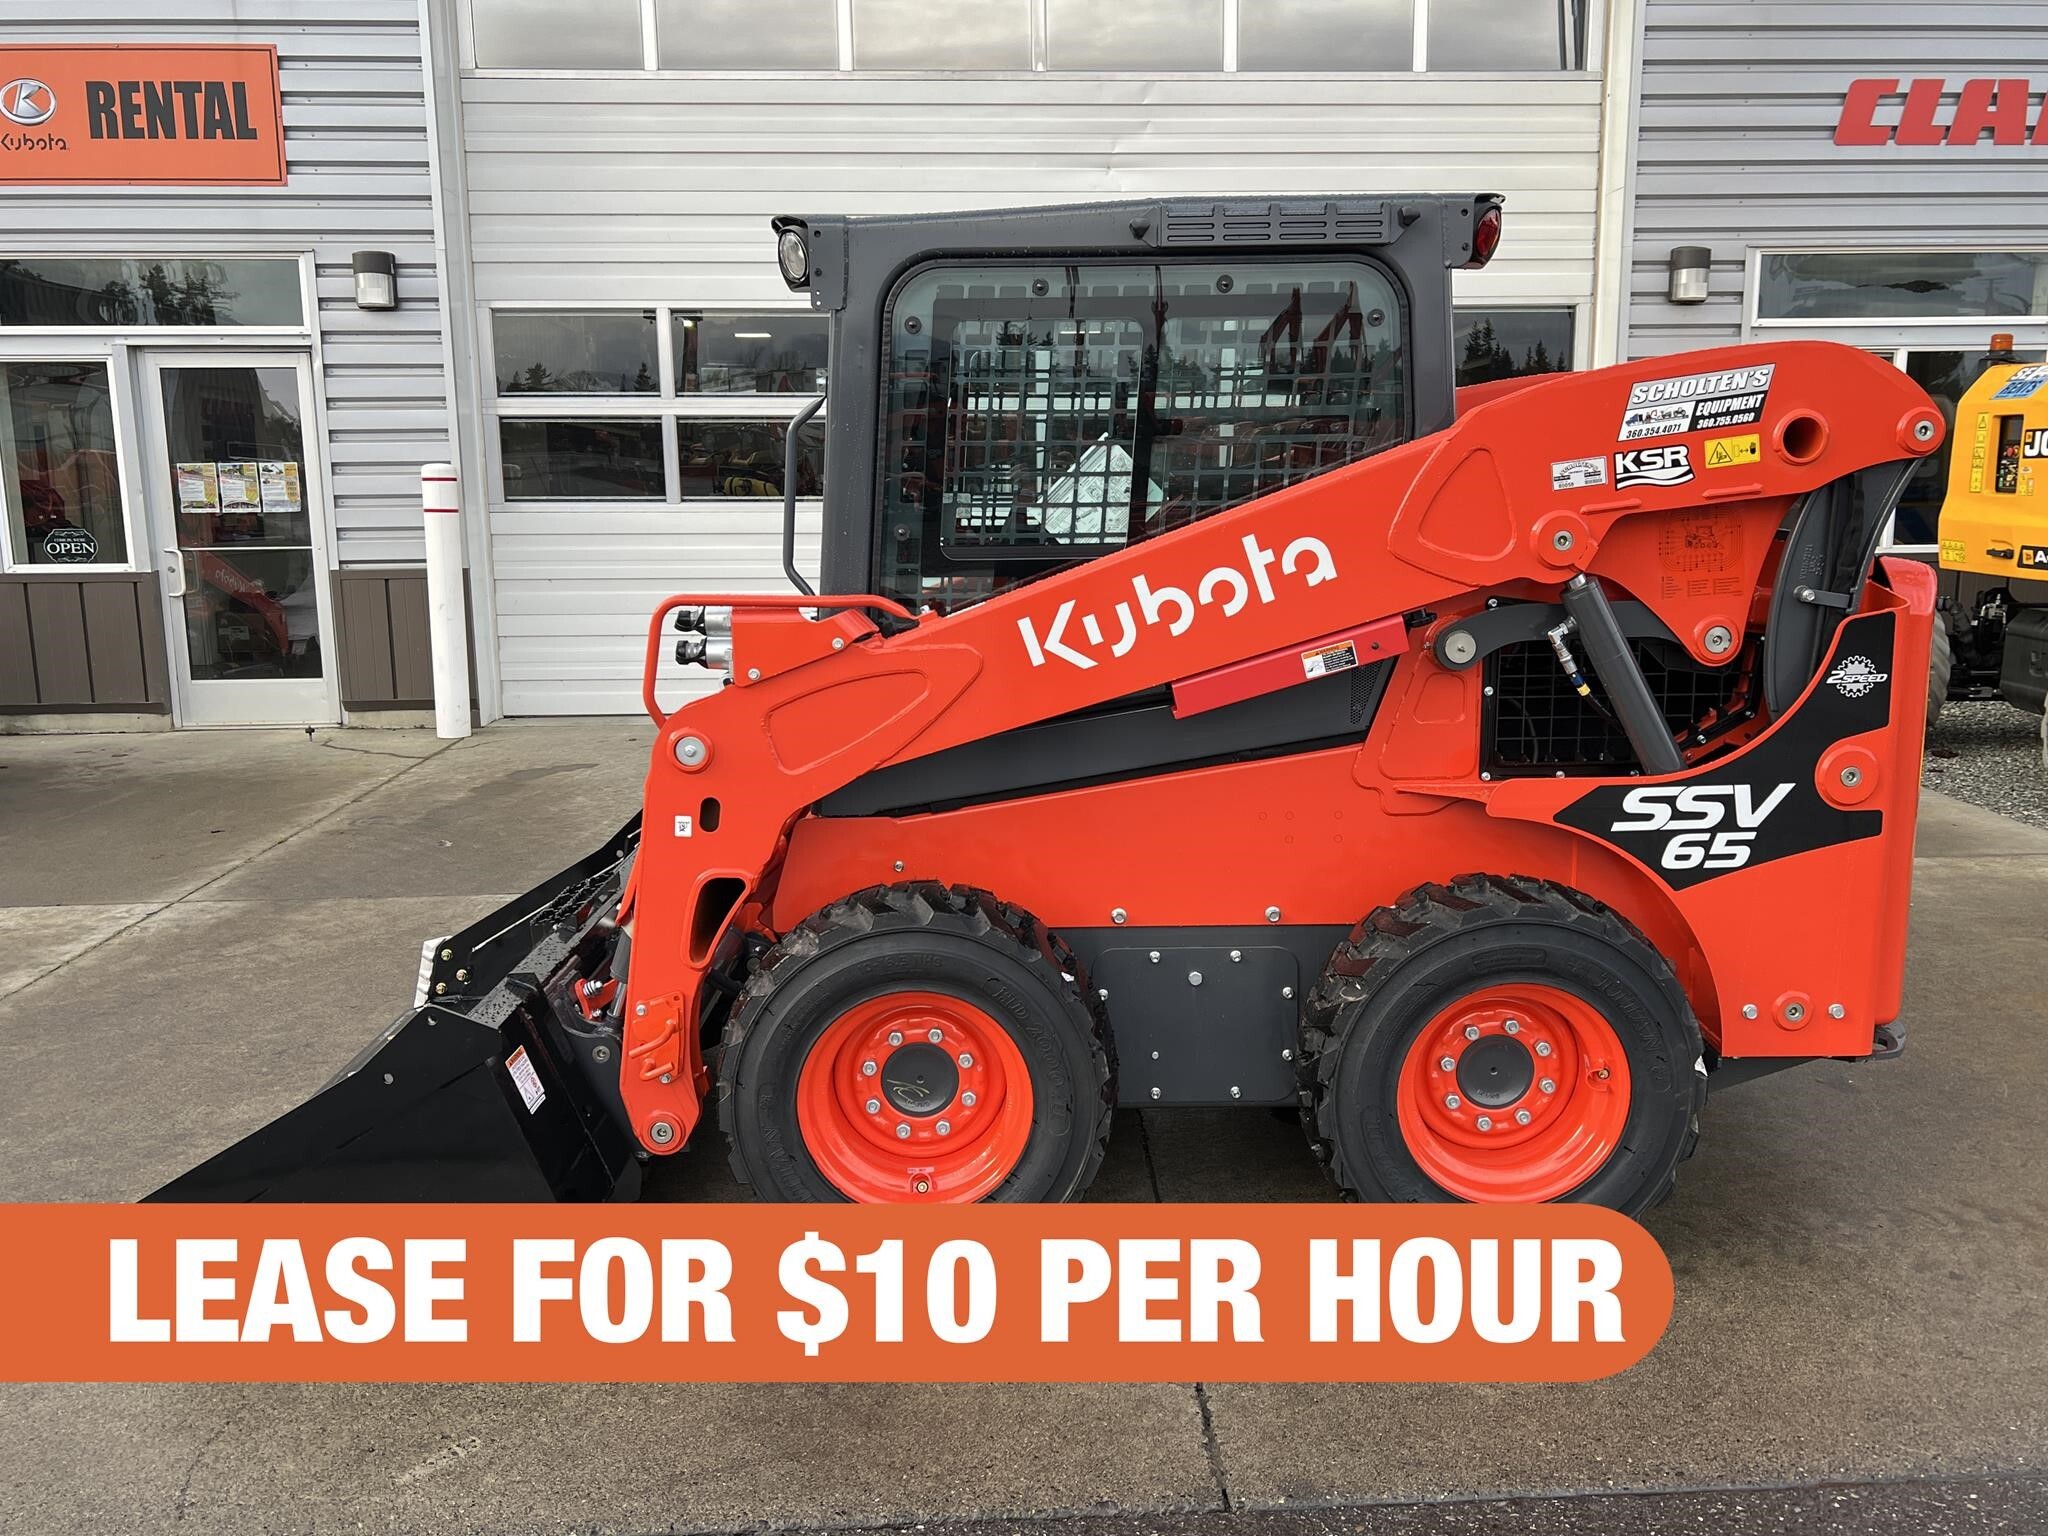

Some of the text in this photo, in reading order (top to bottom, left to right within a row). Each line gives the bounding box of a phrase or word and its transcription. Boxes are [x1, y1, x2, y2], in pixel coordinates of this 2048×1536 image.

[85, 80, 258, 140] RENTAL
[1833, 78, 2048, 146] CLA
[1632, 368, 1769, 404] SCHOLTEN'S
[1695, 394, 1765, 416] EQUIPMENT
[1626, 423, 1682, 439] 360.354.4071
[1616, 445, 1688, 473] KSR
[46, 542, 95, 554] OPEN
[2035, 550, 2048, 564] A
[1016, 533, 1338, 670] Kubota
[1610, 783, 1797, 832] SSV
[1660, 831, 1758, 870] 65
